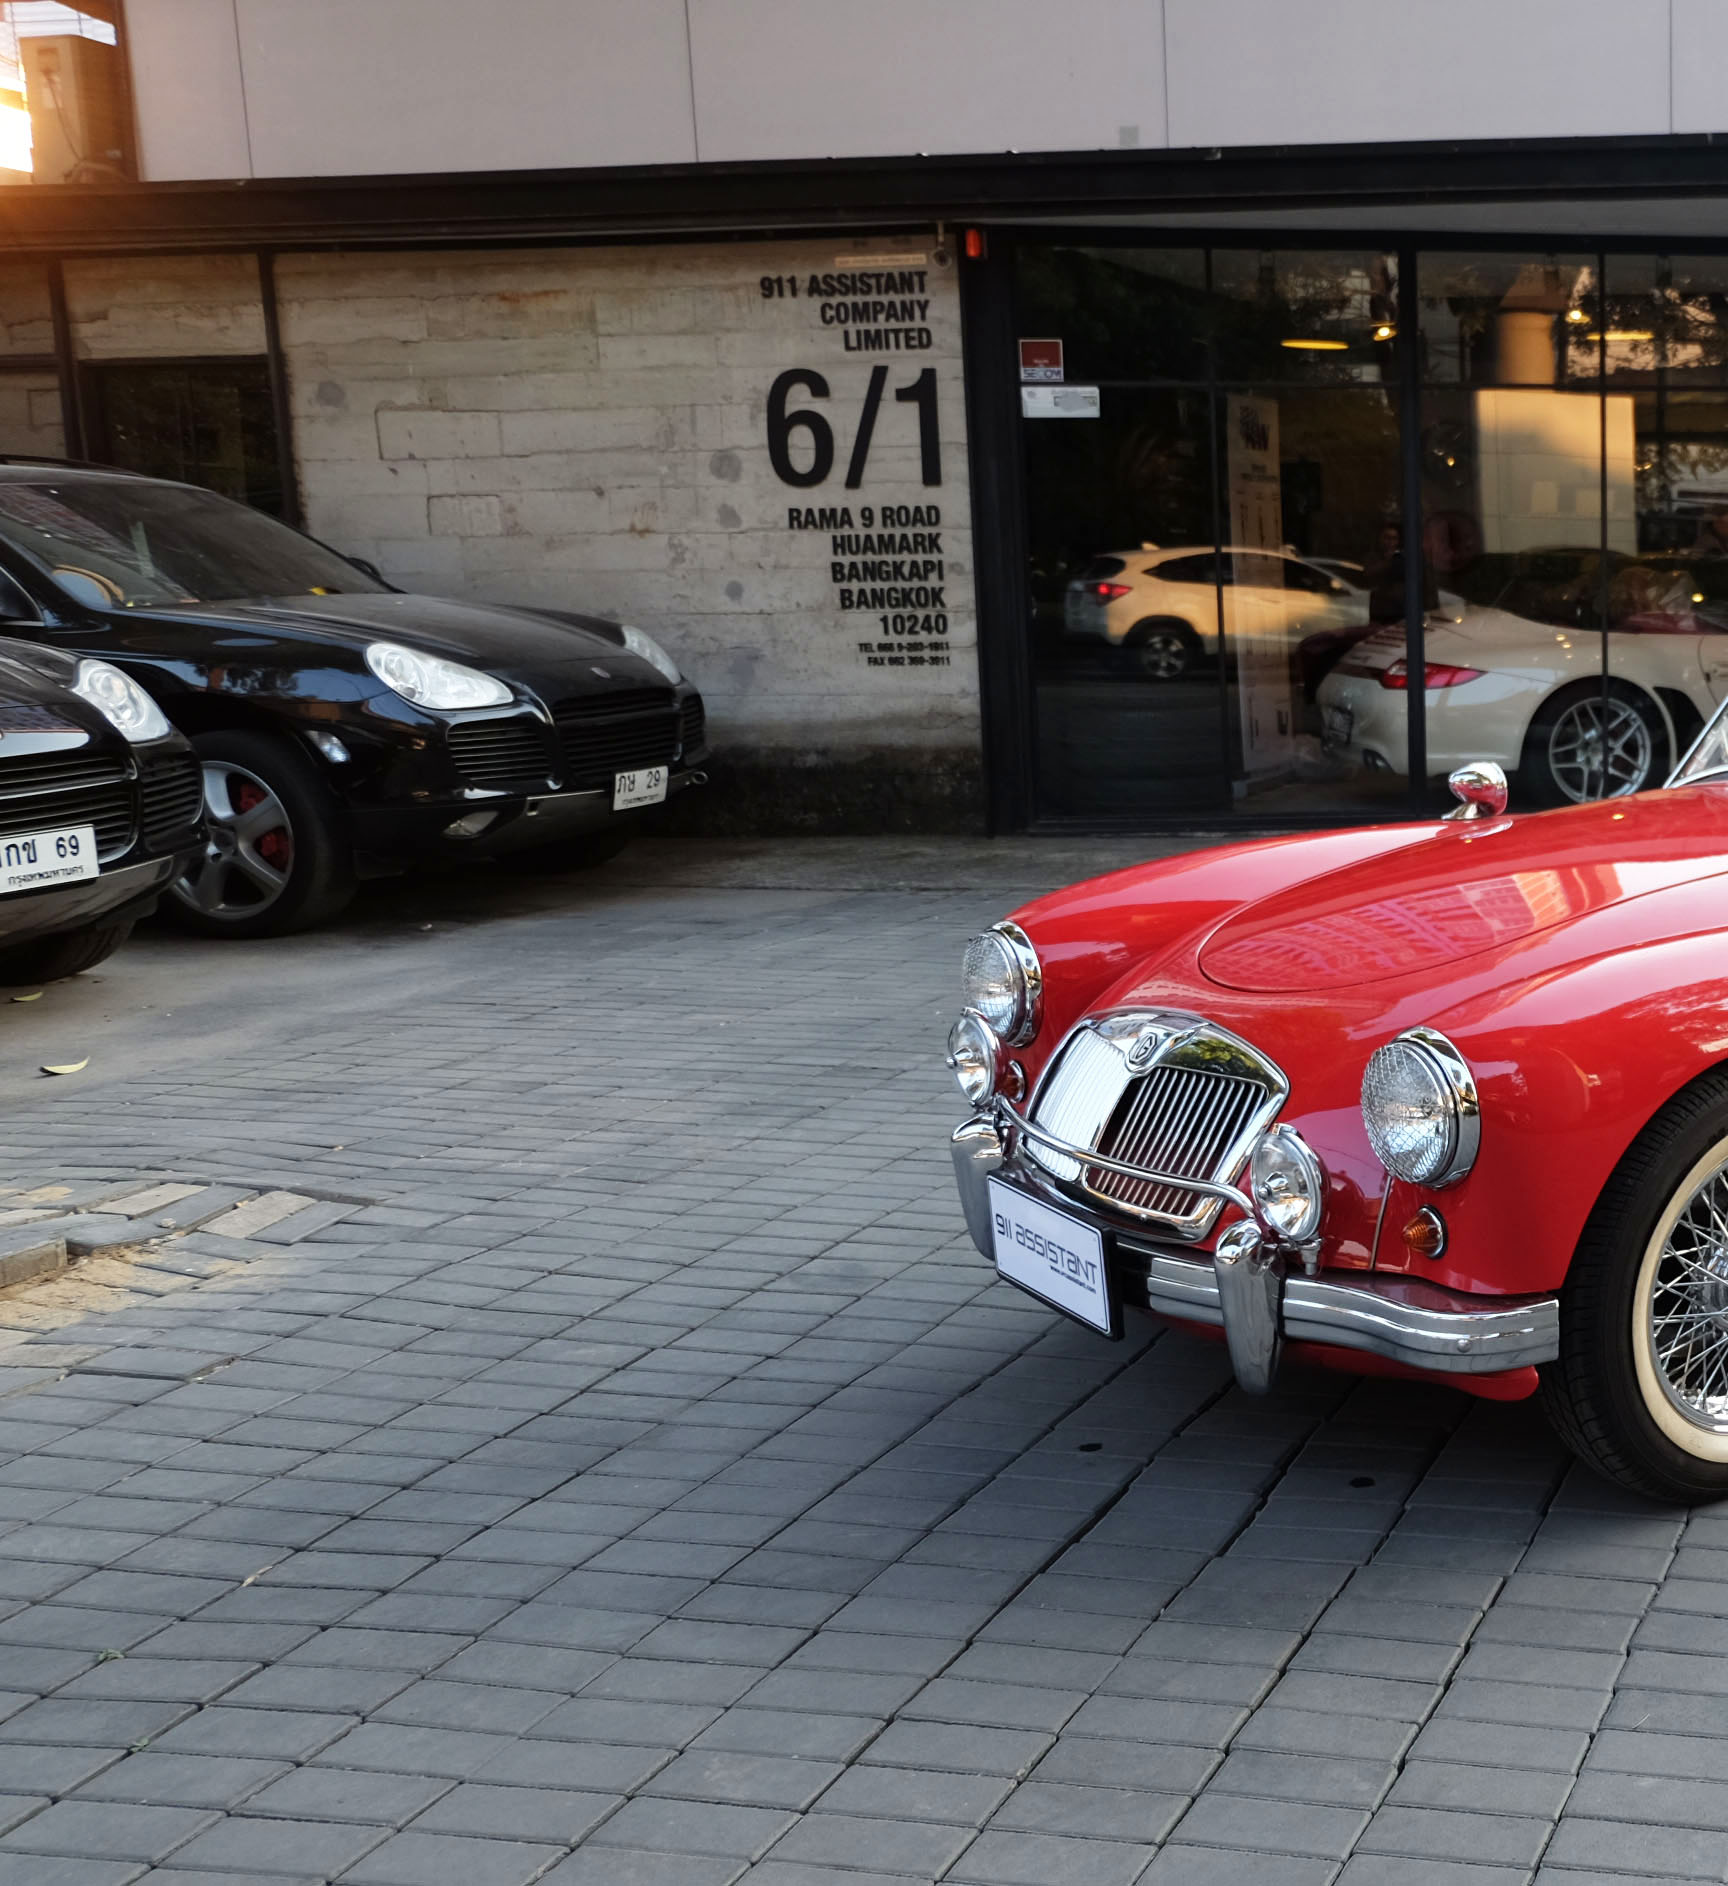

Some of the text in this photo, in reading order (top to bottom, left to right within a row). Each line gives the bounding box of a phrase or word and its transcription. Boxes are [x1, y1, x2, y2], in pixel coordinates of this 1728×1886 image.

[760, 271, 928, 299] 911 ASSISTANT
[820, 299, 930, 325] COMPANY
[843, 327, 932, 352] LIMITED
[766, 365, 943, 489] 6/1
[788, 504, 941, 530] RAMA 9 ROAD
[832, 532, 944, 556] HUAMARK
[831, 560, 944, 583] BANGKAPI
[839, 586, 946, 610] BANGKOK
[880, 613, 948, 636] 10240
[858, 642, 875, 653] TEL
[646, 770, 661, 789] 29
[0, 834, 80, 868] กข 69
[995, 1213, 1013, 1240] 911
